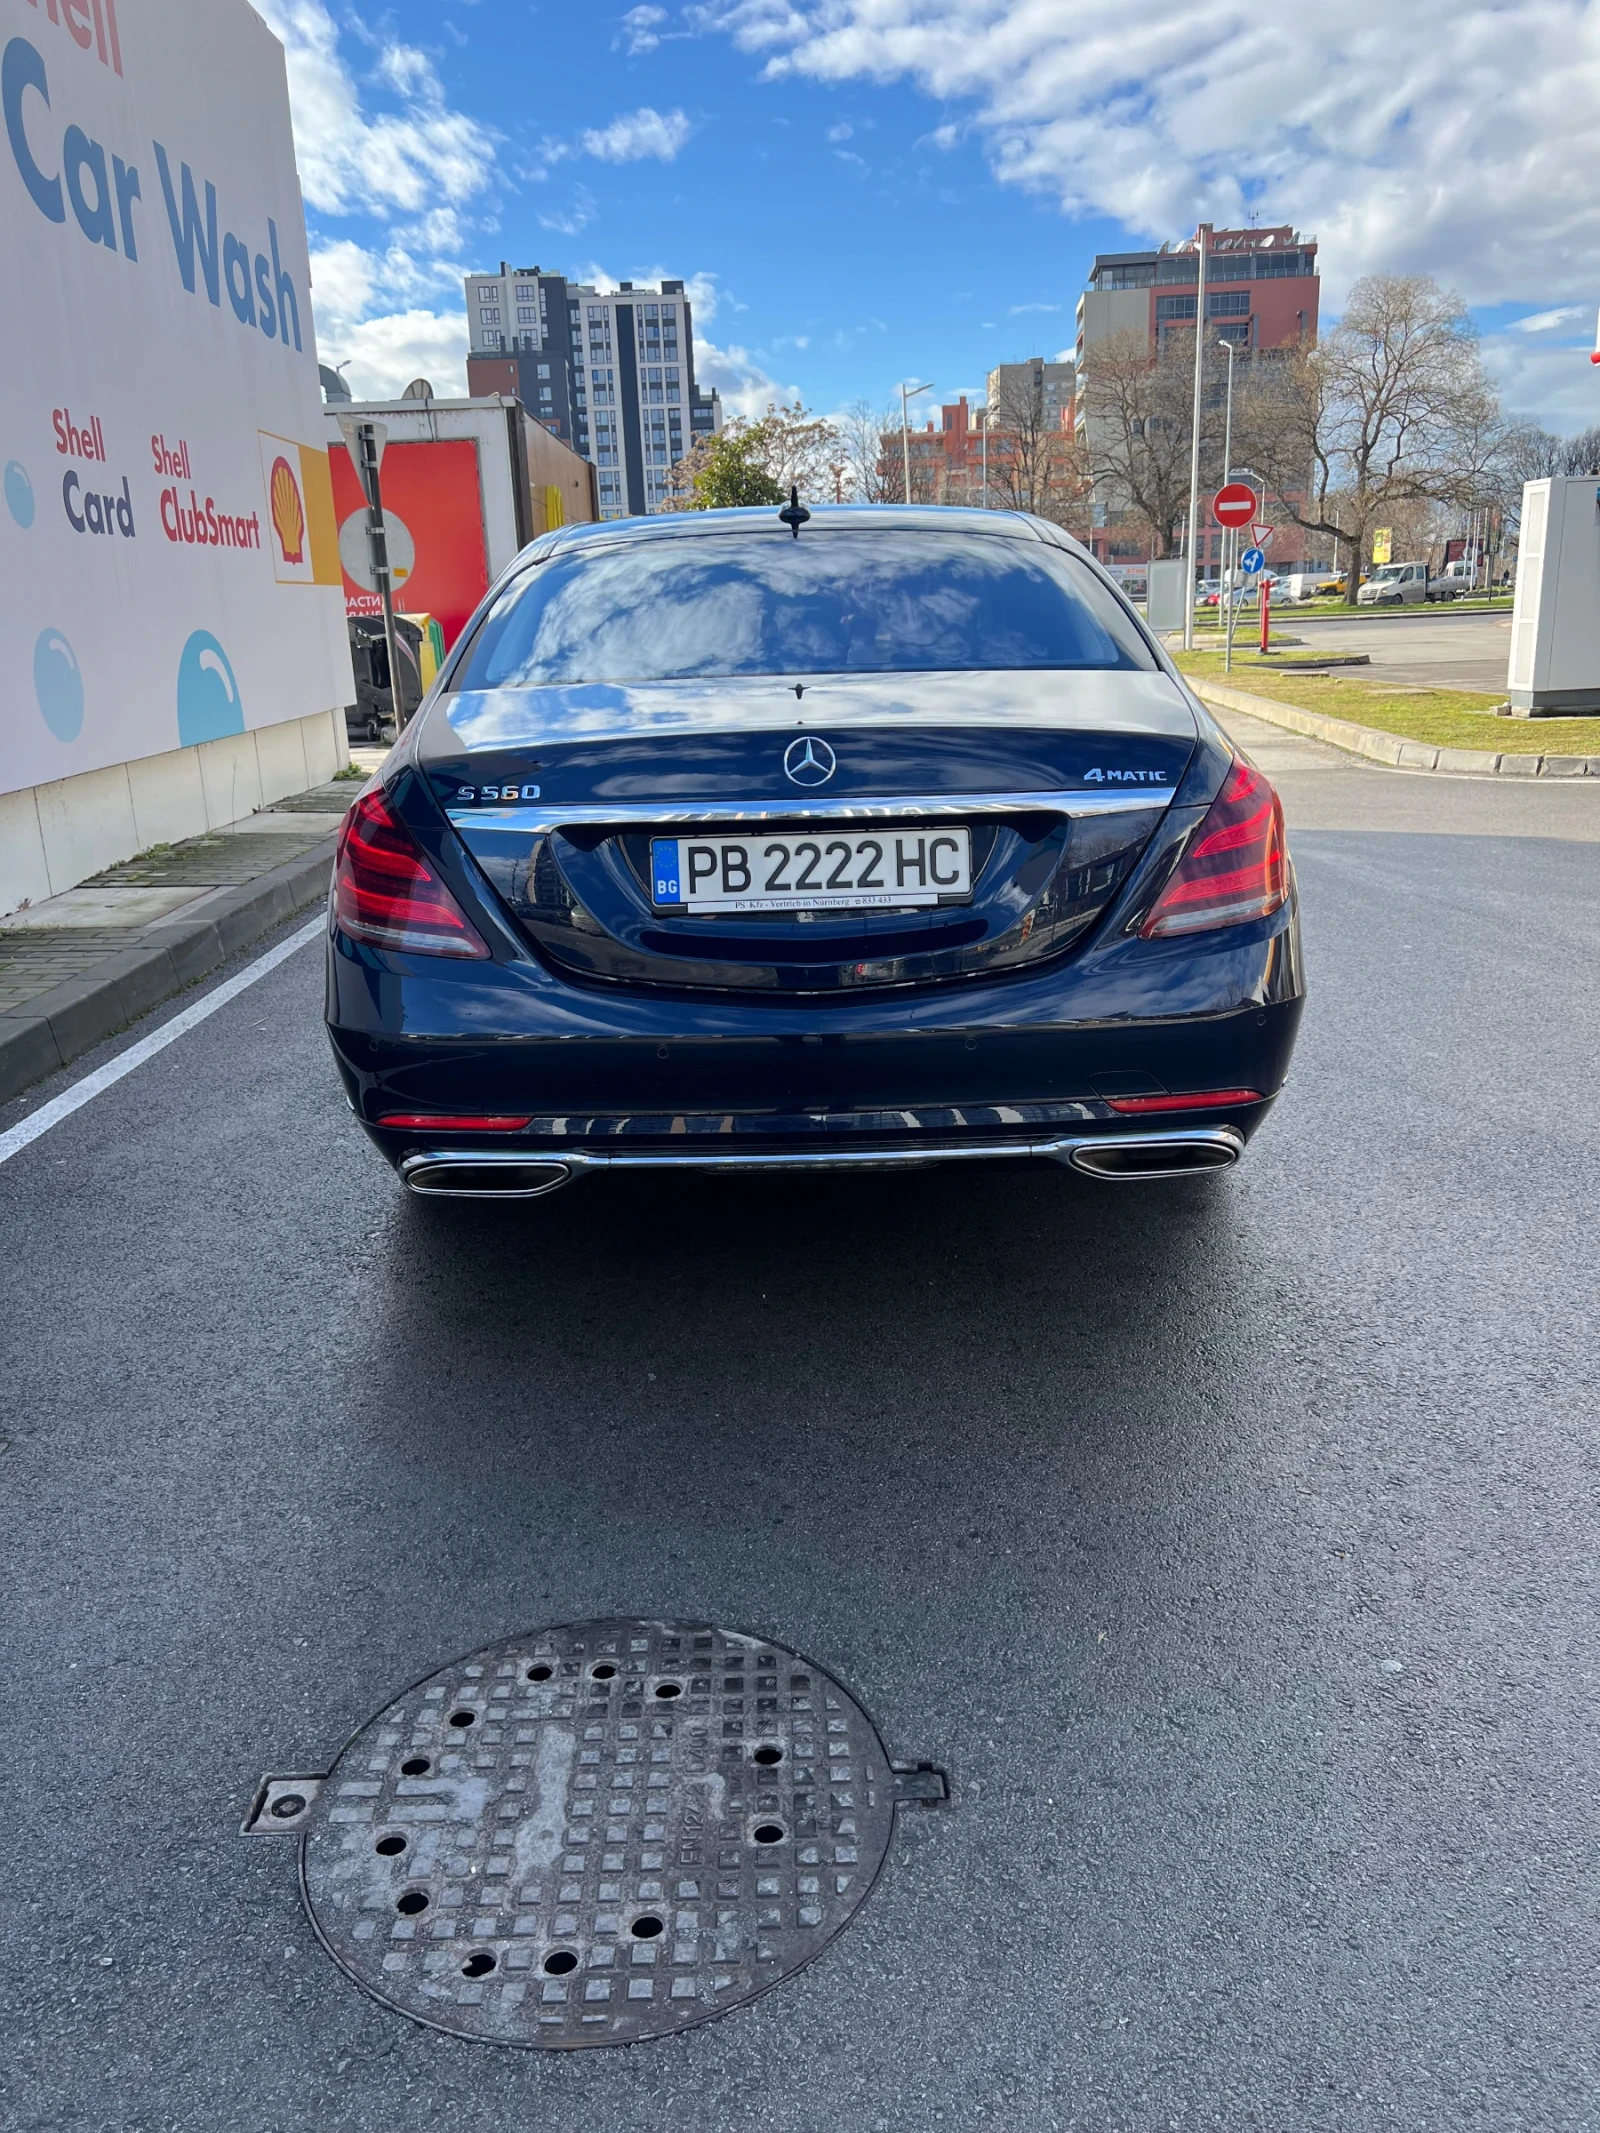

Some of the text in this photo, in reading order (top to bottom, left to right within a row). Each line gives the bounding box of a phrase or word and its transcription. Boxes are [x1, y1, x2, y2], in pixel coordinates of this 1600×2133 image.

[27, 0, 124, 80] ell
[2, 36, 302, 353] Car Wash
[52, 408, 106, 462] Shell
[151, 434, 191, 480] Shell
[62, 469, 136, 538] Card
[160, 486, 260, 549] ClubSmart
[456, 785, 541, 801] S 560
[1083, 767, 1168, 782] 4MATIC
[656, 880, 678, 895] BG
[687, 837, 960, 894] PB 2222 HC
[735, 901, 746, 910] PS
[750, 900, 763, 909] Kfz
[770, 899, 801, 908] Vertrieb
[803, 899, 811, 907] in
